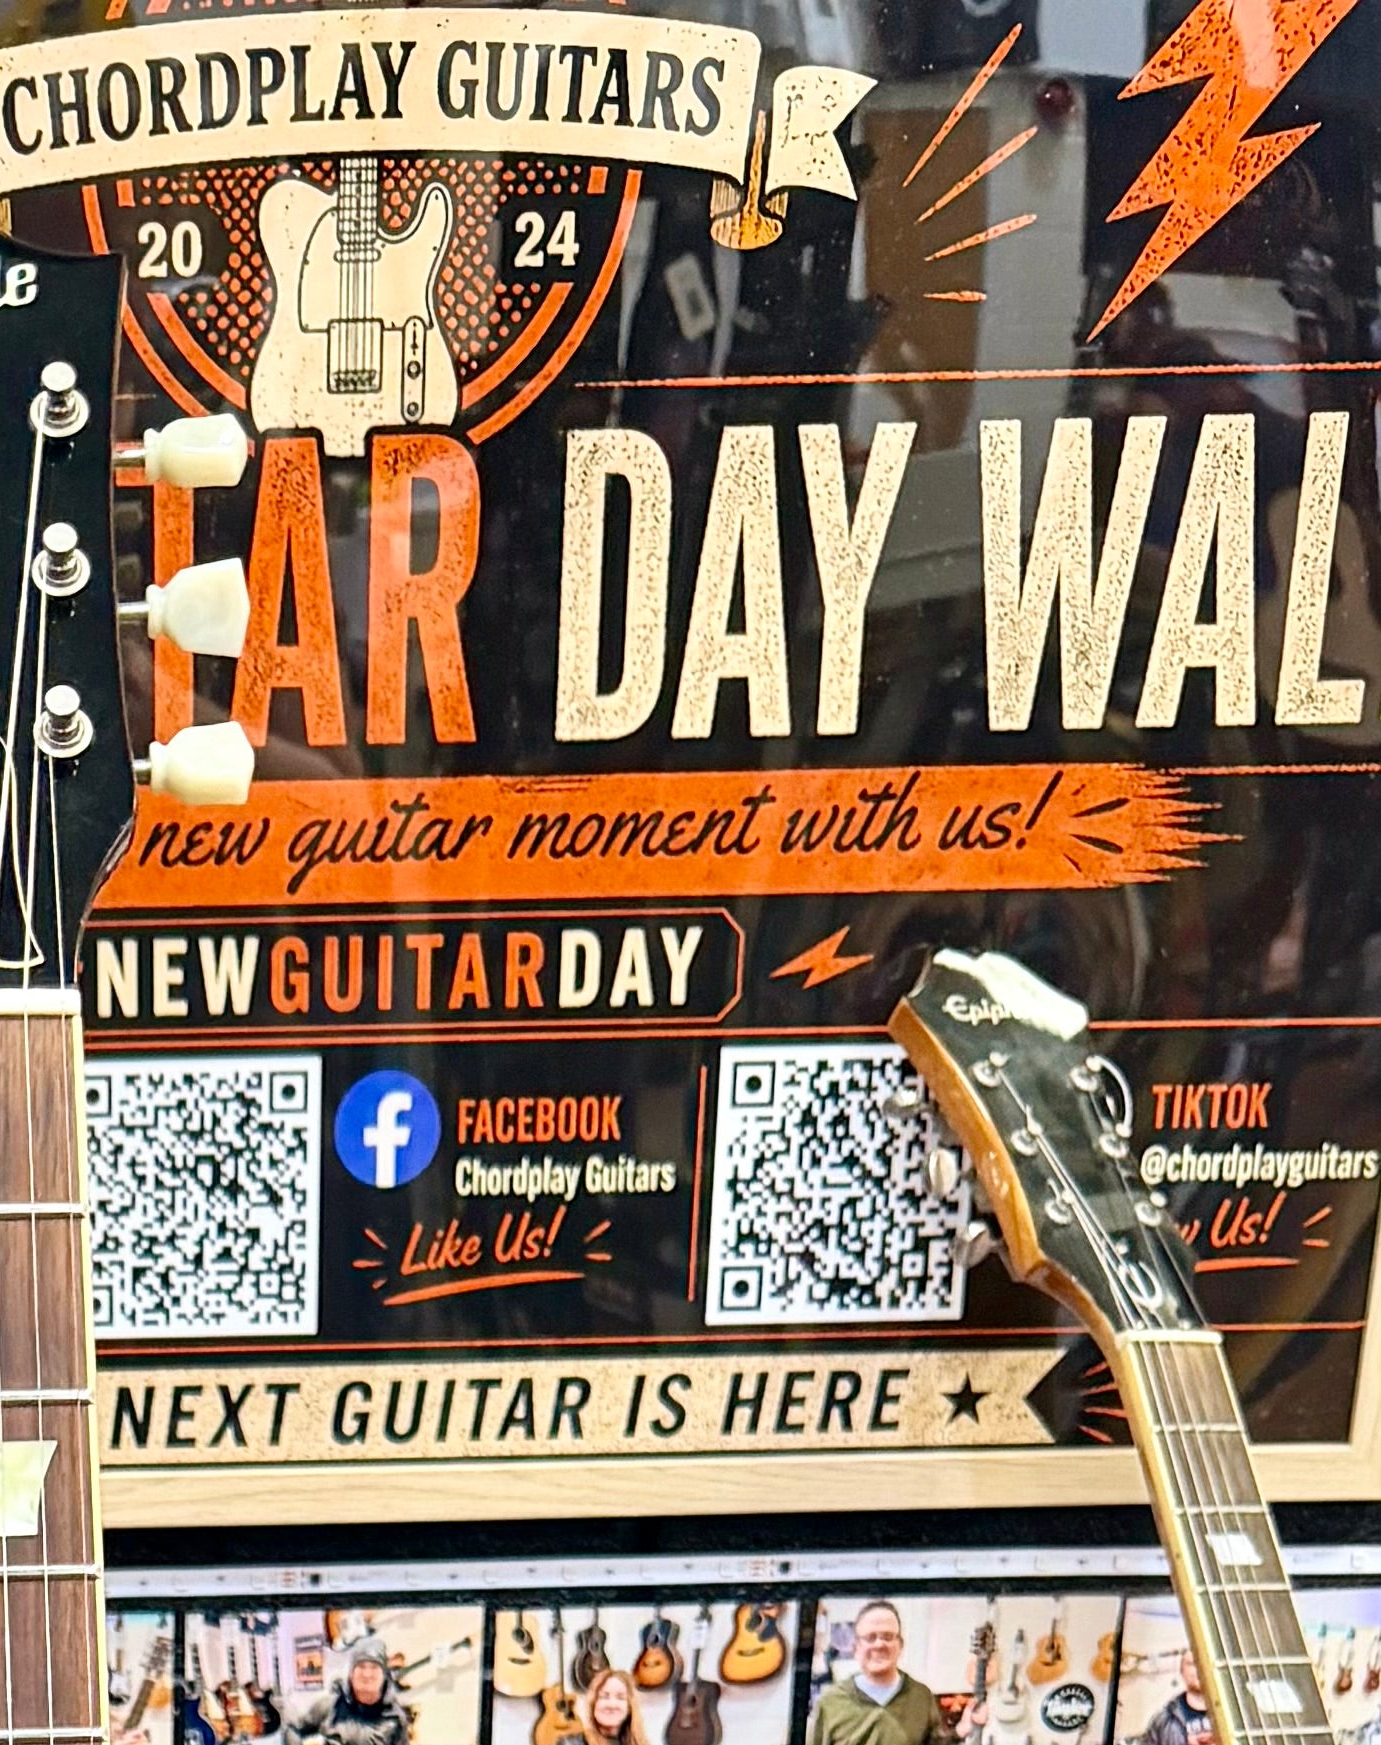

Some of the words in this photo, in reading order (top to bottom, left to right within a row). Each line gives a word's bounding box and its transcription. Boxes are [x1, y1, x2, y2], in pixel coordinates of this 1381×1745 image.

[2, 41, 418, 155] CHORDPLAY
[436, 40, 726, 137] GUITARS
[137, 221, 202, 279] 20
[515, 210, 580, 268] 24
[116, 433, 479, 747] TAR
[555, 422, 917, 741] DAY
[979, 411, 1367, 732] WAL
[138, 815, 269, 868] new
[286, 792, 493, 895] guitar
[506, 785, 775, 862] moment
[785, 769, 925, 852] with
[938, 769, 1066, 849] us!
[456, 1095, 622, 1145] FACEBOOK
[1152, 1082, 1273, 1130] TIKTOK
[455, 1153, 581, 1203] Chordplay
[585, 1152, 677, 1195] Guitars
[1139, 1141, 1380, 1189] @chordplayguitars
[399, 1216, 481, 1276] Like
[493, 1203, 568, 1264] Us!
[1209, 1190, 1288, 1249] Us!
[109, 1381, 301, 1450] NEXT
[331, 1375, 593, 1445] GUITAR
[624, 1372, 694, 1439] IS
[721, 1368, 911, 1435] HERE
